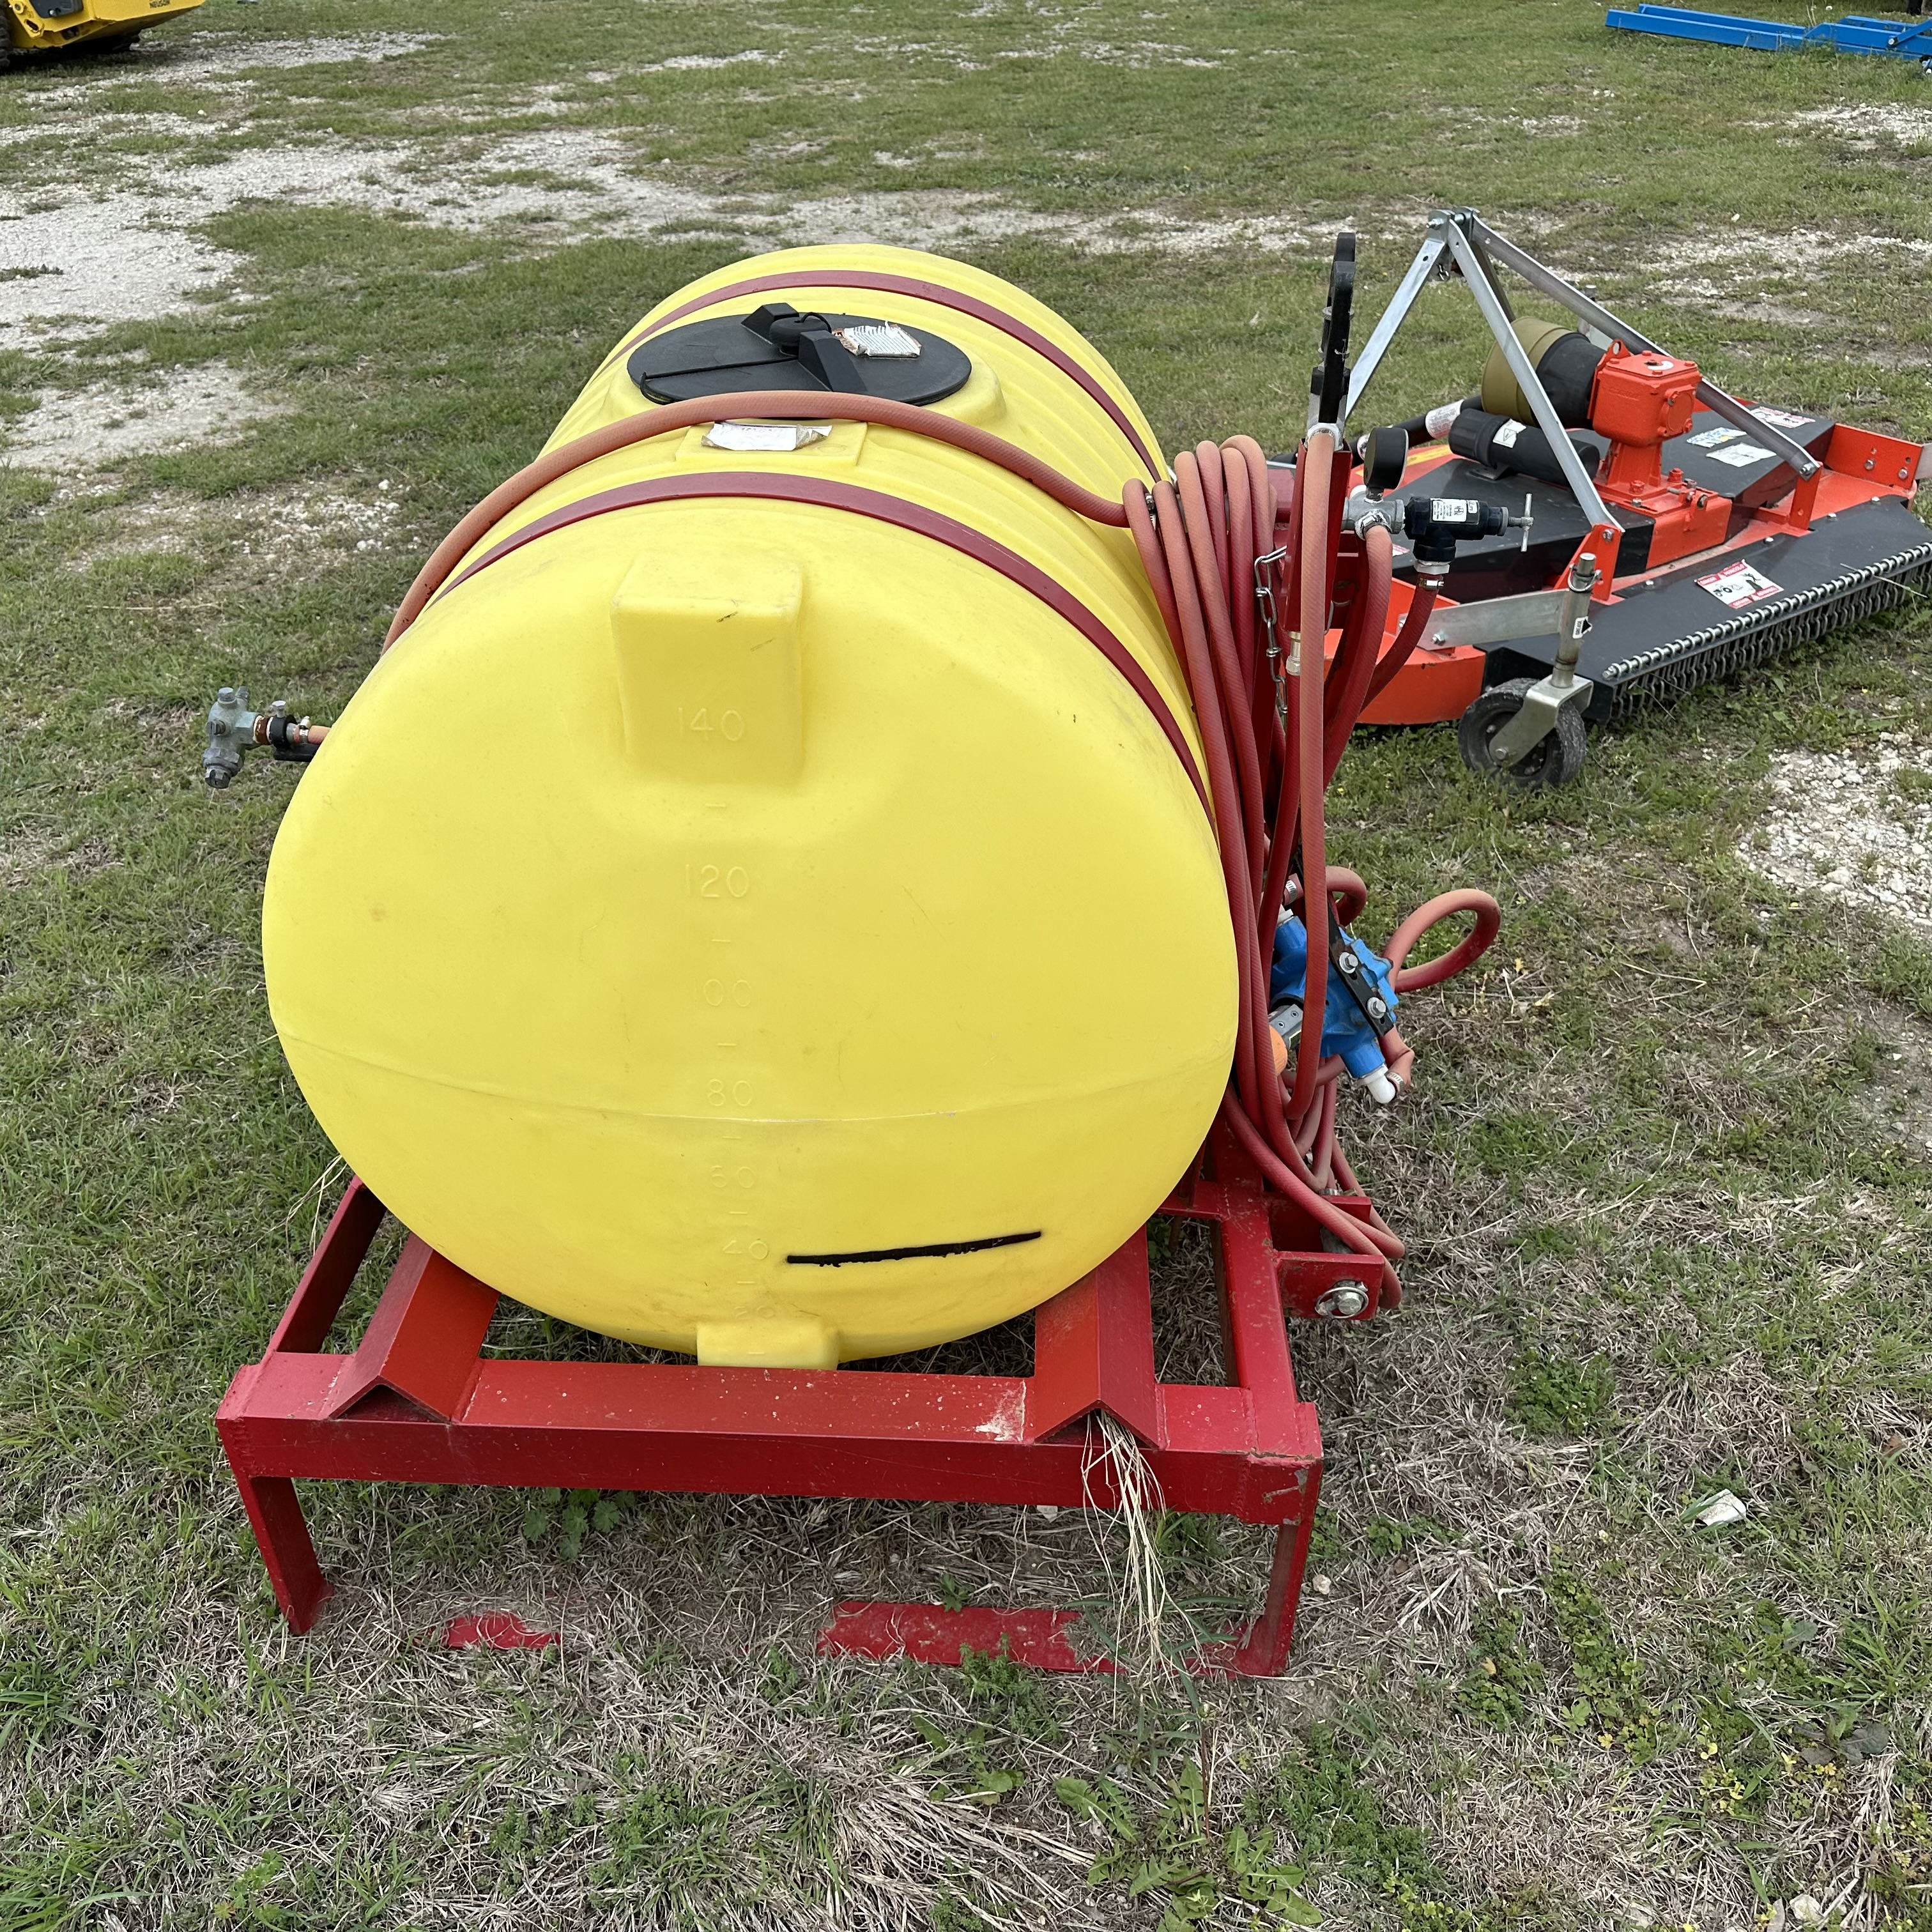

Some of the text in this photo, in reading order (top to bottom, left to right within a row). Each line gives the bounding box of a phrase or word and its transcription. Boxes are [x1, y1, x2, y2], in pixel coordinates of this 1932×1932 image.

[677, 707, 746, 742] 140
[685, 864, 750, 898] 120
[707, 1078, 755, 1107] 80
[709, 1164, 756, 1189] 60
[722, 1239, 770, 1261] 40
